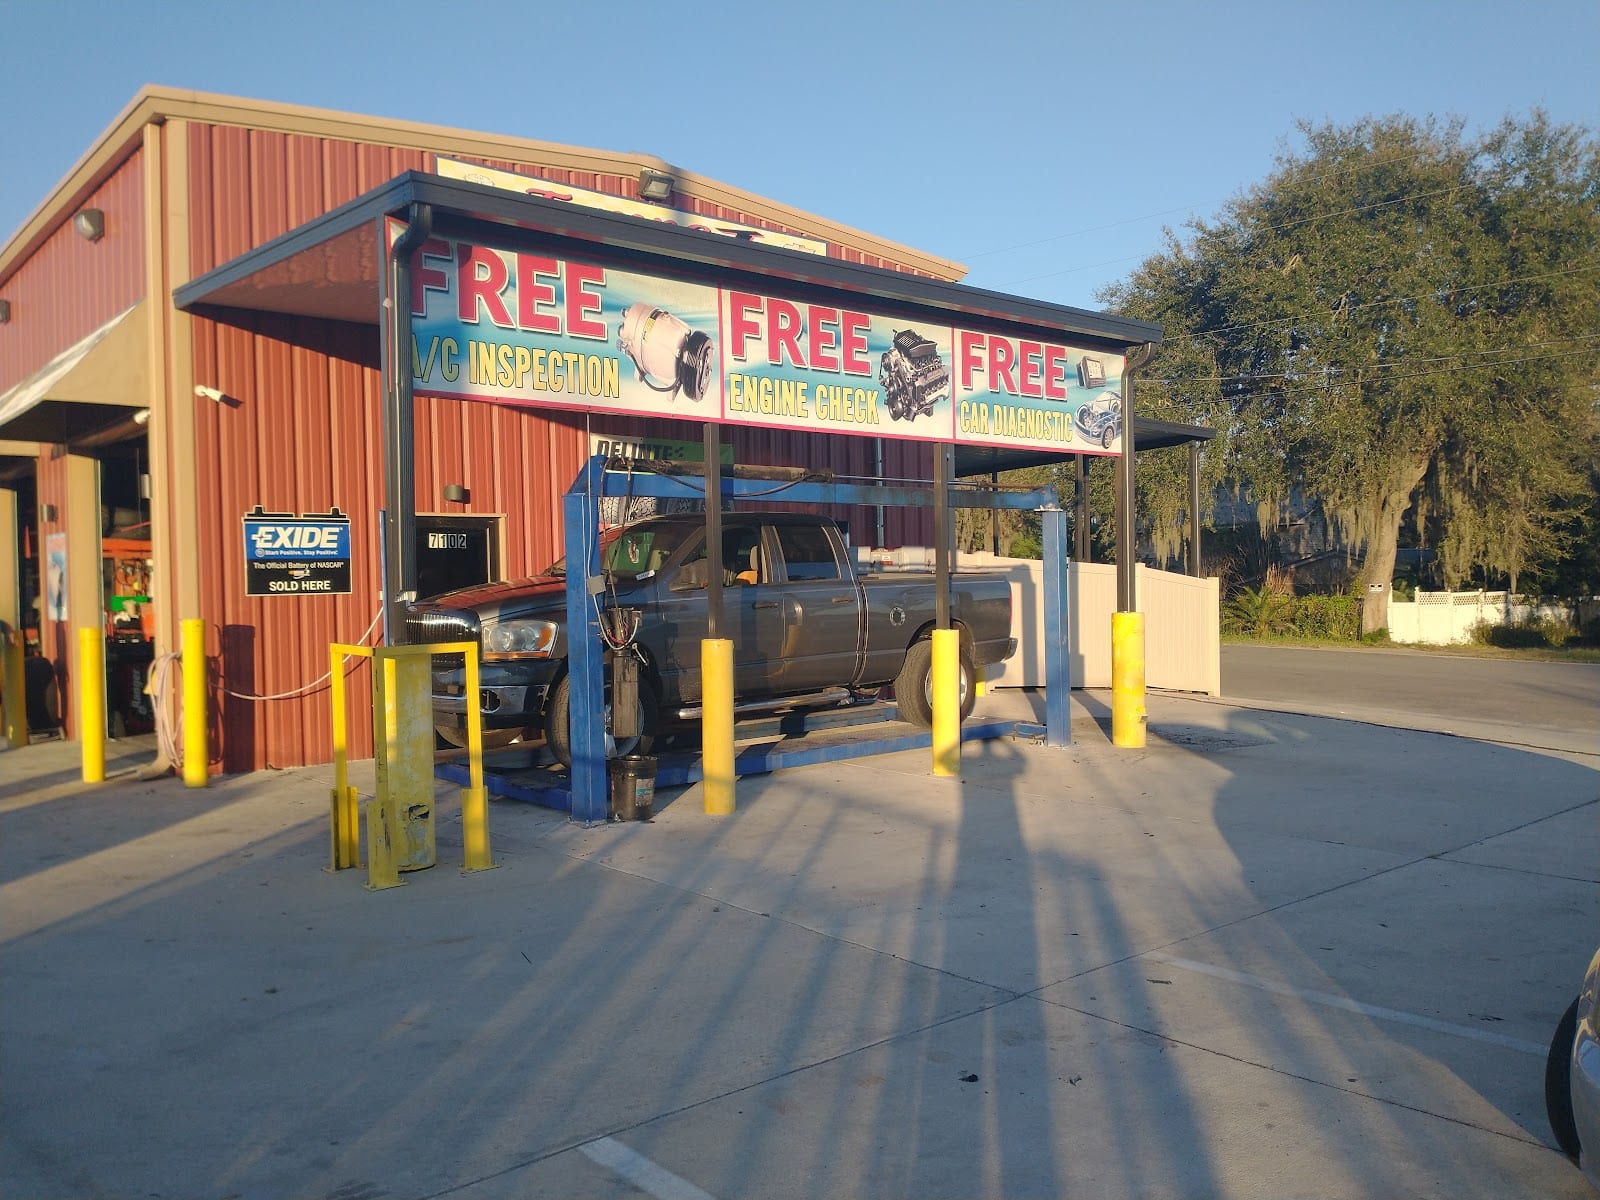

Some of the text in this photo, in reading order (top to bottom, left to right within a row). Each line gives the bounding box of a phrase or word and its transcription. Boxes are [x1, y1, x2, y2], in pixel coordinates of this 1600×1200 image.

[411, 239, 608, 341] FREE
[729, 290, 873, 377] FREE
[468, 340, 620, 399] INSPECTION
[960, 330, 1067, 401] FREE
[729, 373, 880, 424] ENGINE CHECK
[959, 400, 1073, 443] CAR DIAGNOSTIC
[251, 526, 340, 548] EXIDE
[430, 534, 466, 548] 7102
[269, 581, 331, 591] SOLD HERE
[288, 562, 309, 570] Battery
